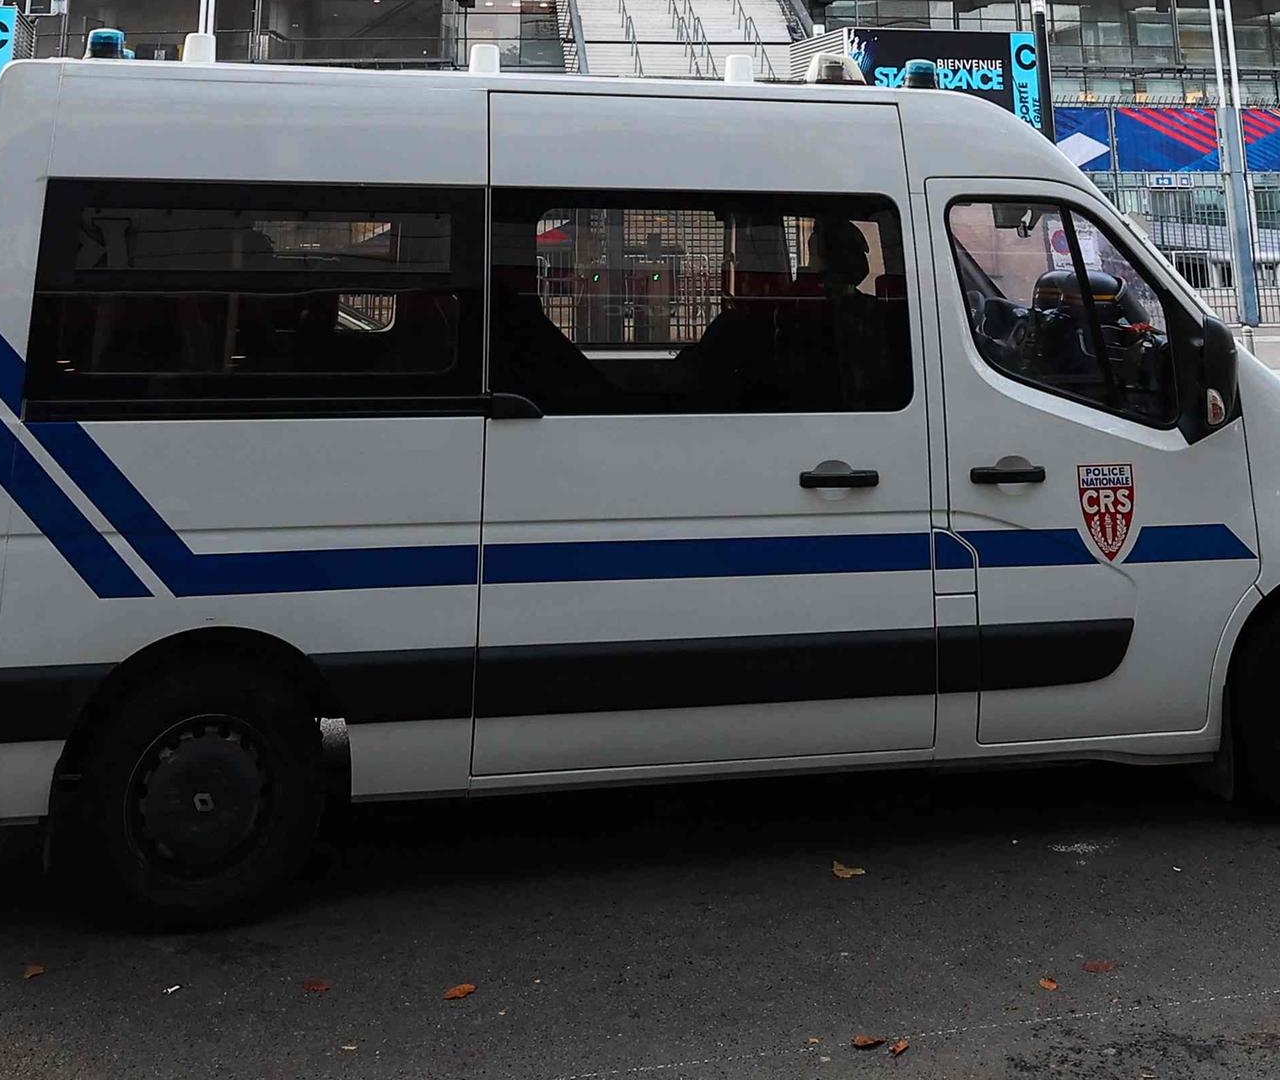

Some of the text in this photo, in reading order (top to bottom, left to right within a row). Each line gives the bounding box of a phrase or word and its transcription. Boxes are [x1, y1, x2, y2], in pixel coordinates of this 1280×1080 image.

[936, 58, 1003, 70] BIENVENUE
[1015, 43, 1036, 70] C
[1018, 82, 1031, 123] PORTE
[1085, 467, 1125, 477] POLICE
[1082, 477, 1130, 487] NATIONALE
[1082, 489, 1132, 514] CRS
